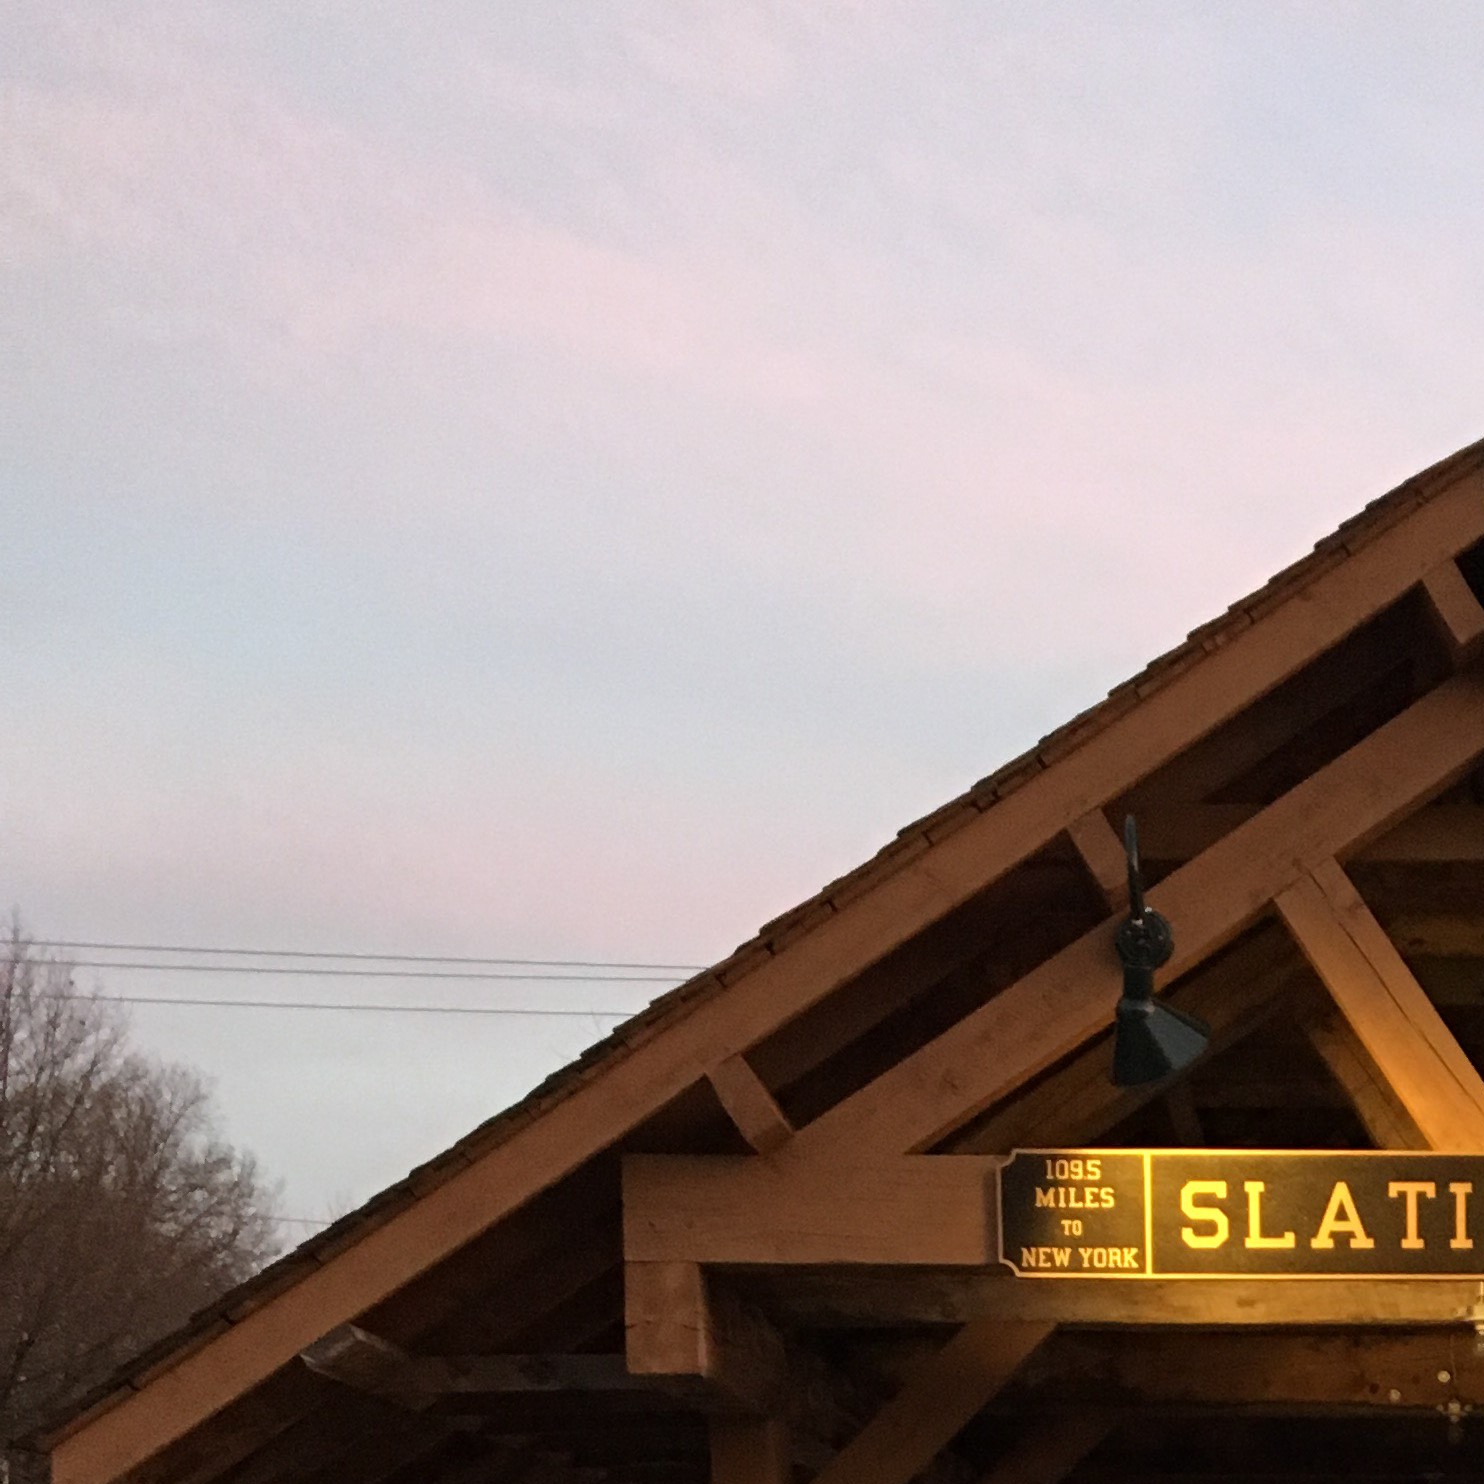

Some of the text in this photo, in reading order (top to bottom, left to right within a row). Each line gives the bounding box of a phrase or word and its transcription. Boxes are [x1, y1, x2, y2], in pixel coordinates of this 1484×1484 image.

[1035, 1187, 1115, 1208] MILES
[1060, 1219, 1083, 1236] TO
[1021, 1247, 1139, 1268] NEW YORK
